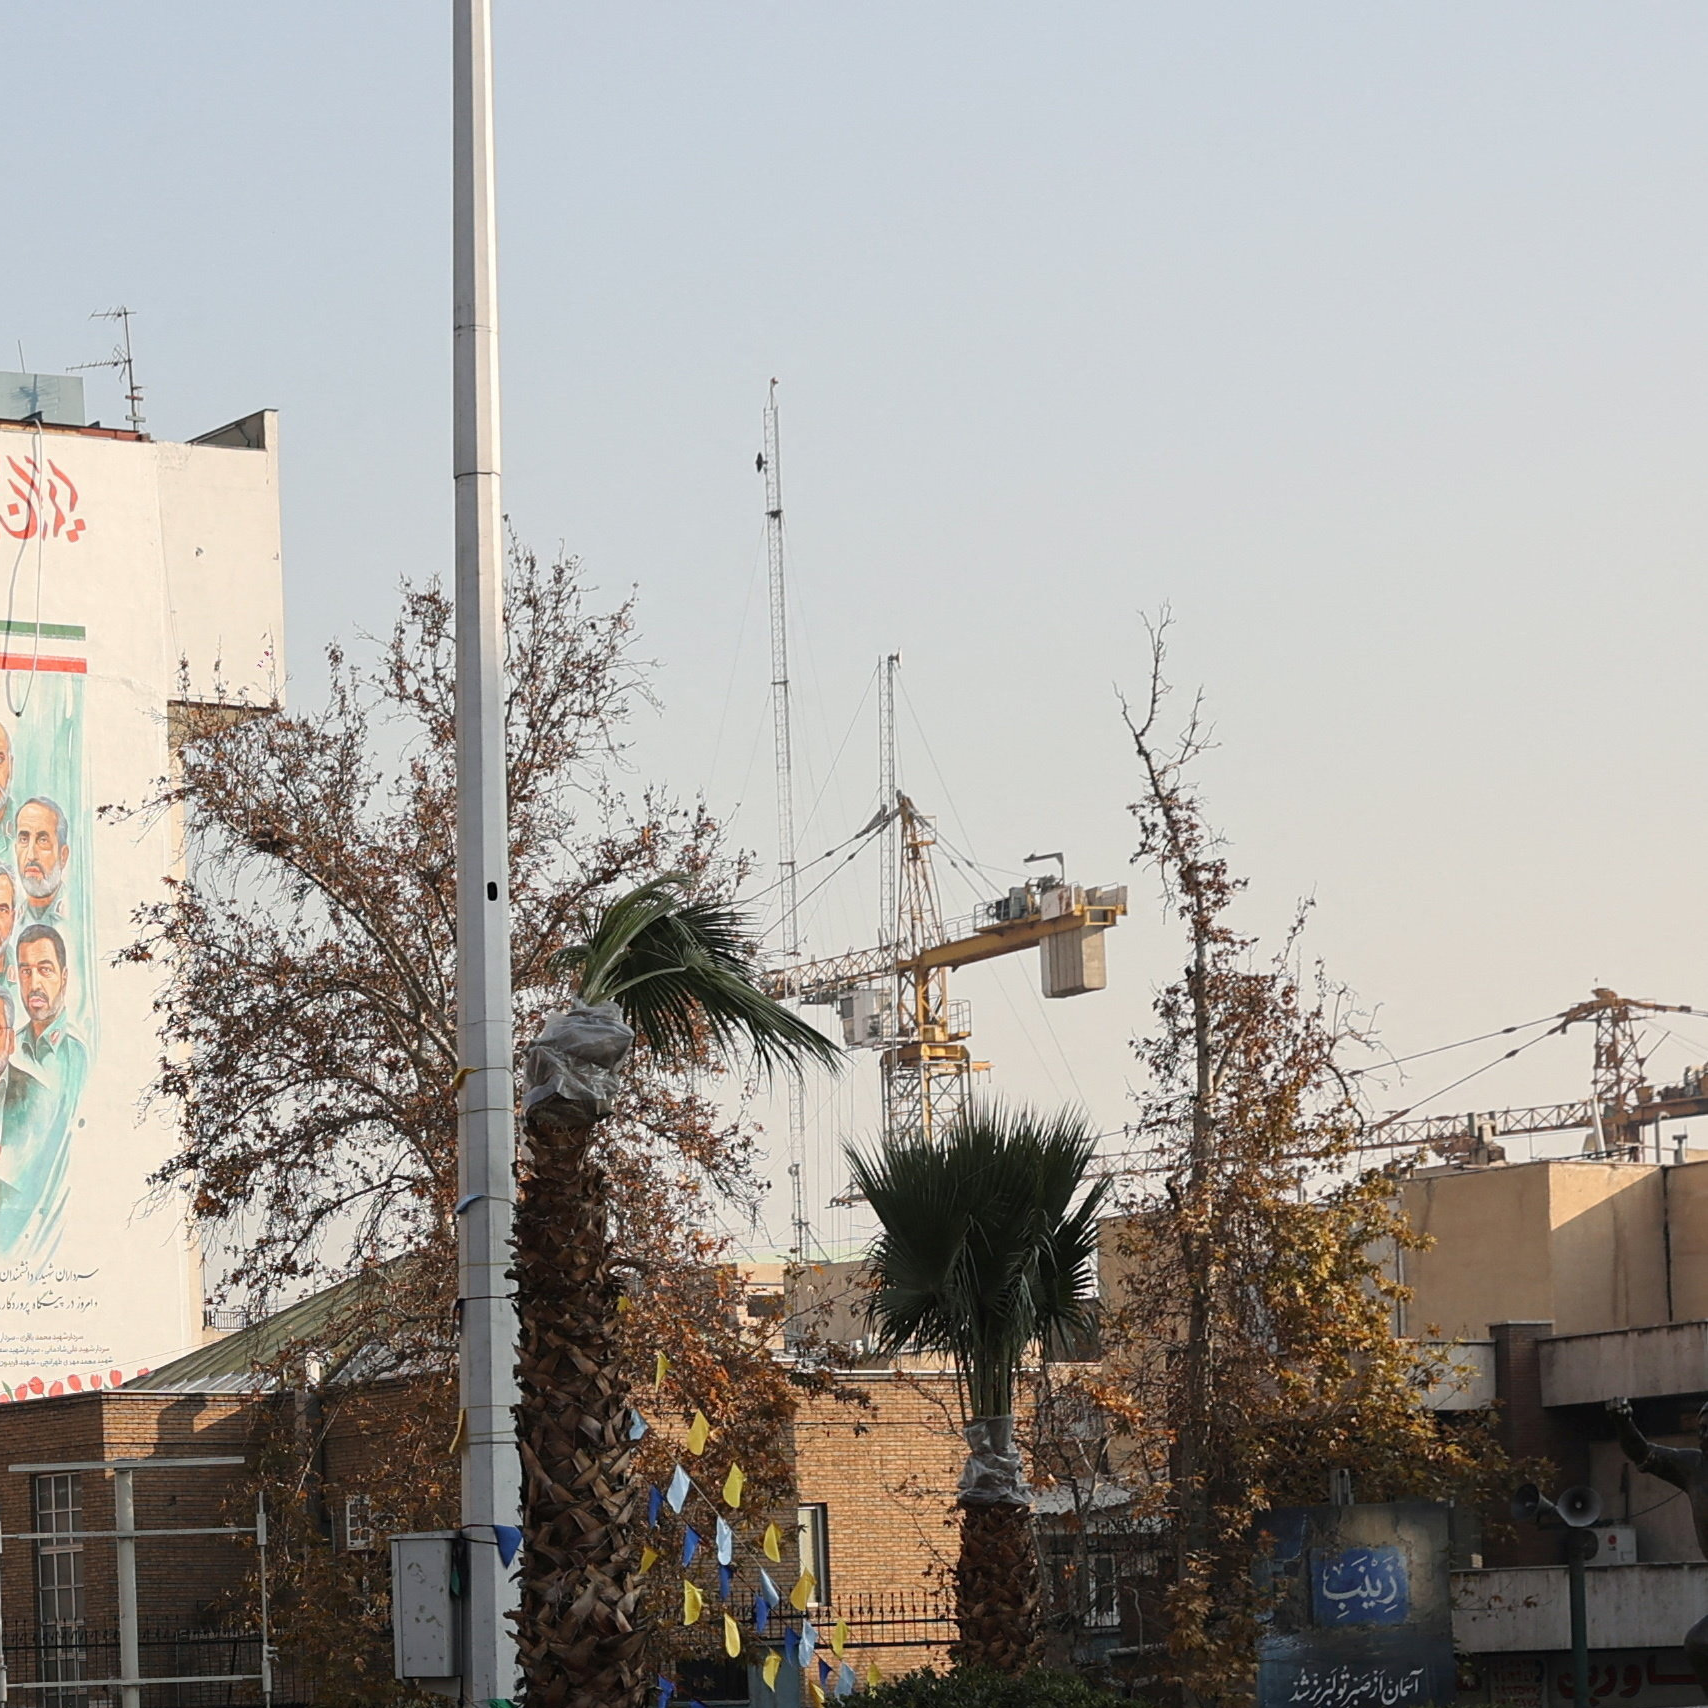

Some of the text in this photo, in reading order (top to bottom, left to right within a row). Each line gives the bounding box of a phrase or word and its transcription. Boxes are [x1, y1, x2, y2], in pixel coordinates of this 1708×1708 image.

[0, 1261, 34, 1283] دانشمندان
[56, 1268, 100, 1282] سرداران
[32, 1289, 65, 1310] پیشگاه
[66, 1299, 75, 1310] در
[77, 1296, 94, 1313] امروز
